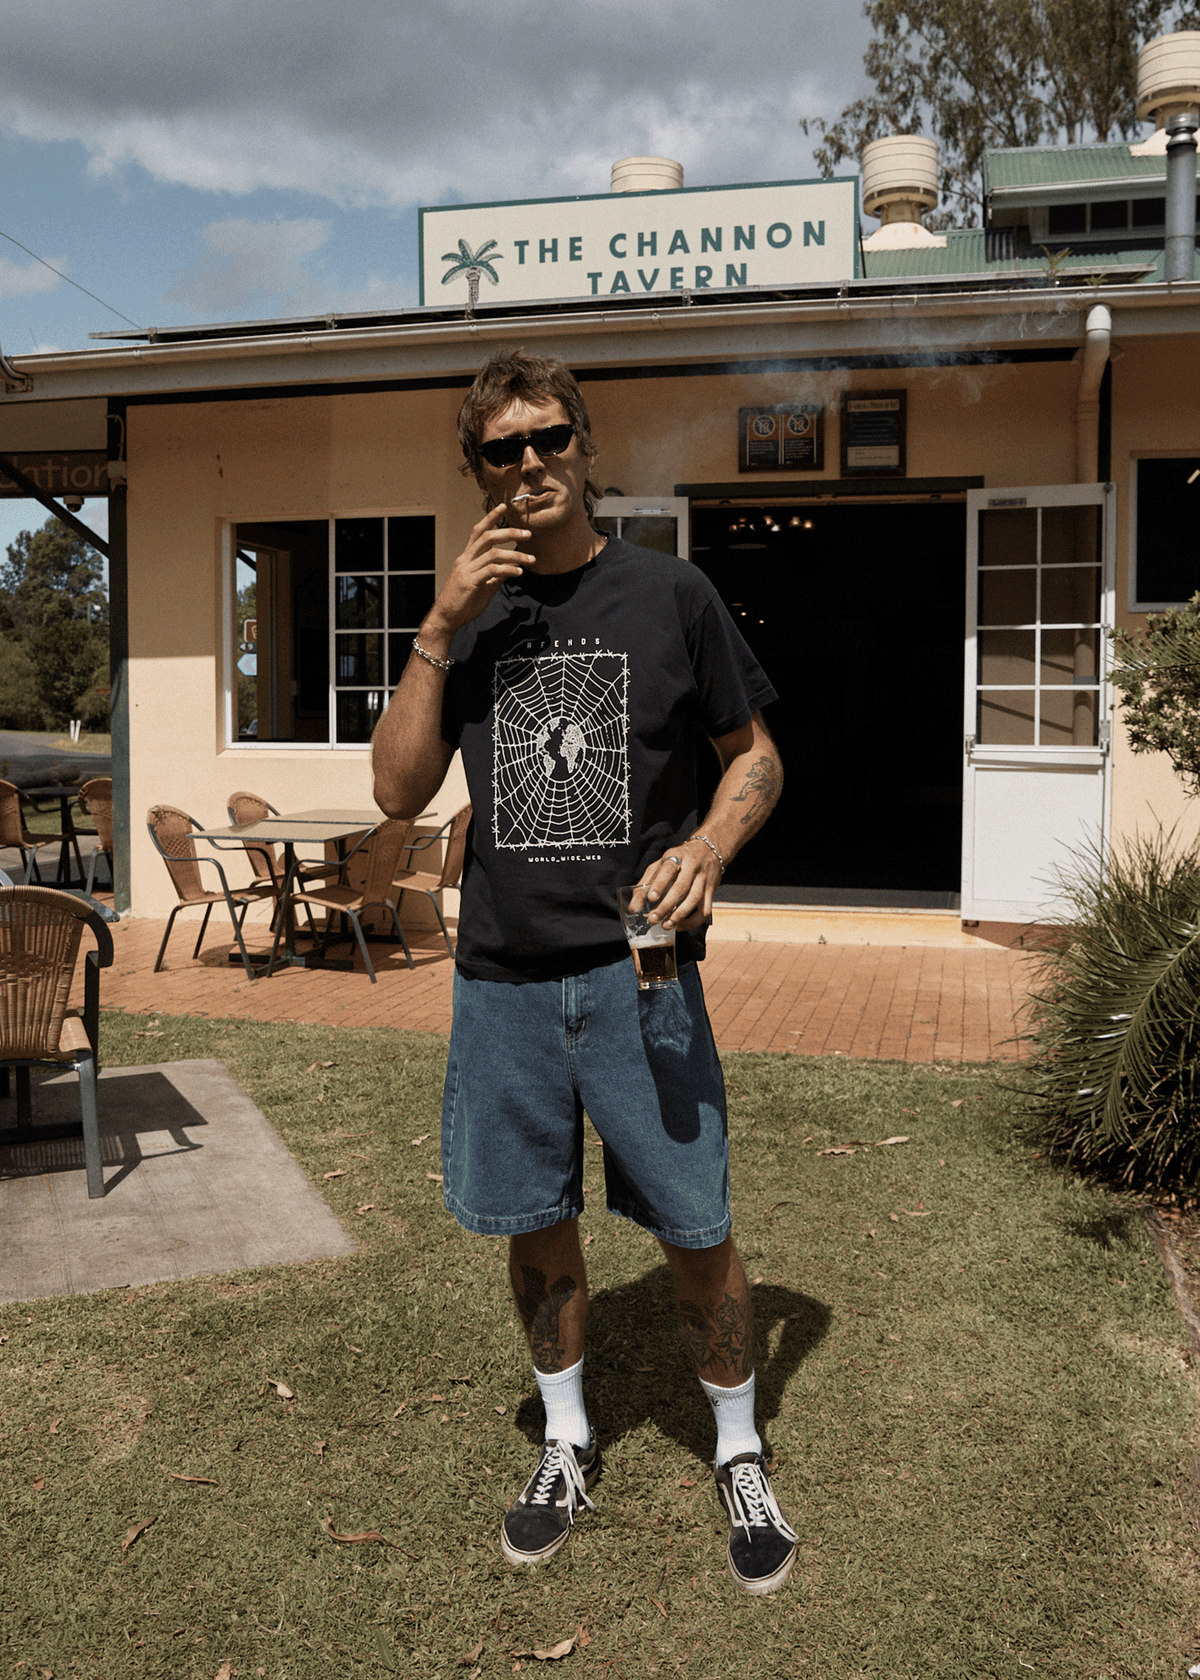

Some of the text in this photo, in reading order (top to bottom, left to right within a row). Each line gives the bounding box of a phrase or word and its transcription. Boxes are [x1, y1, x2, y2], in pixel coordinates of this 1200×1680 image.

[513, 220, 826, 264] THE CHANNON
[587, 262, 748, 294] TAVERN
[526, 637, 600, 649] AFENDS
